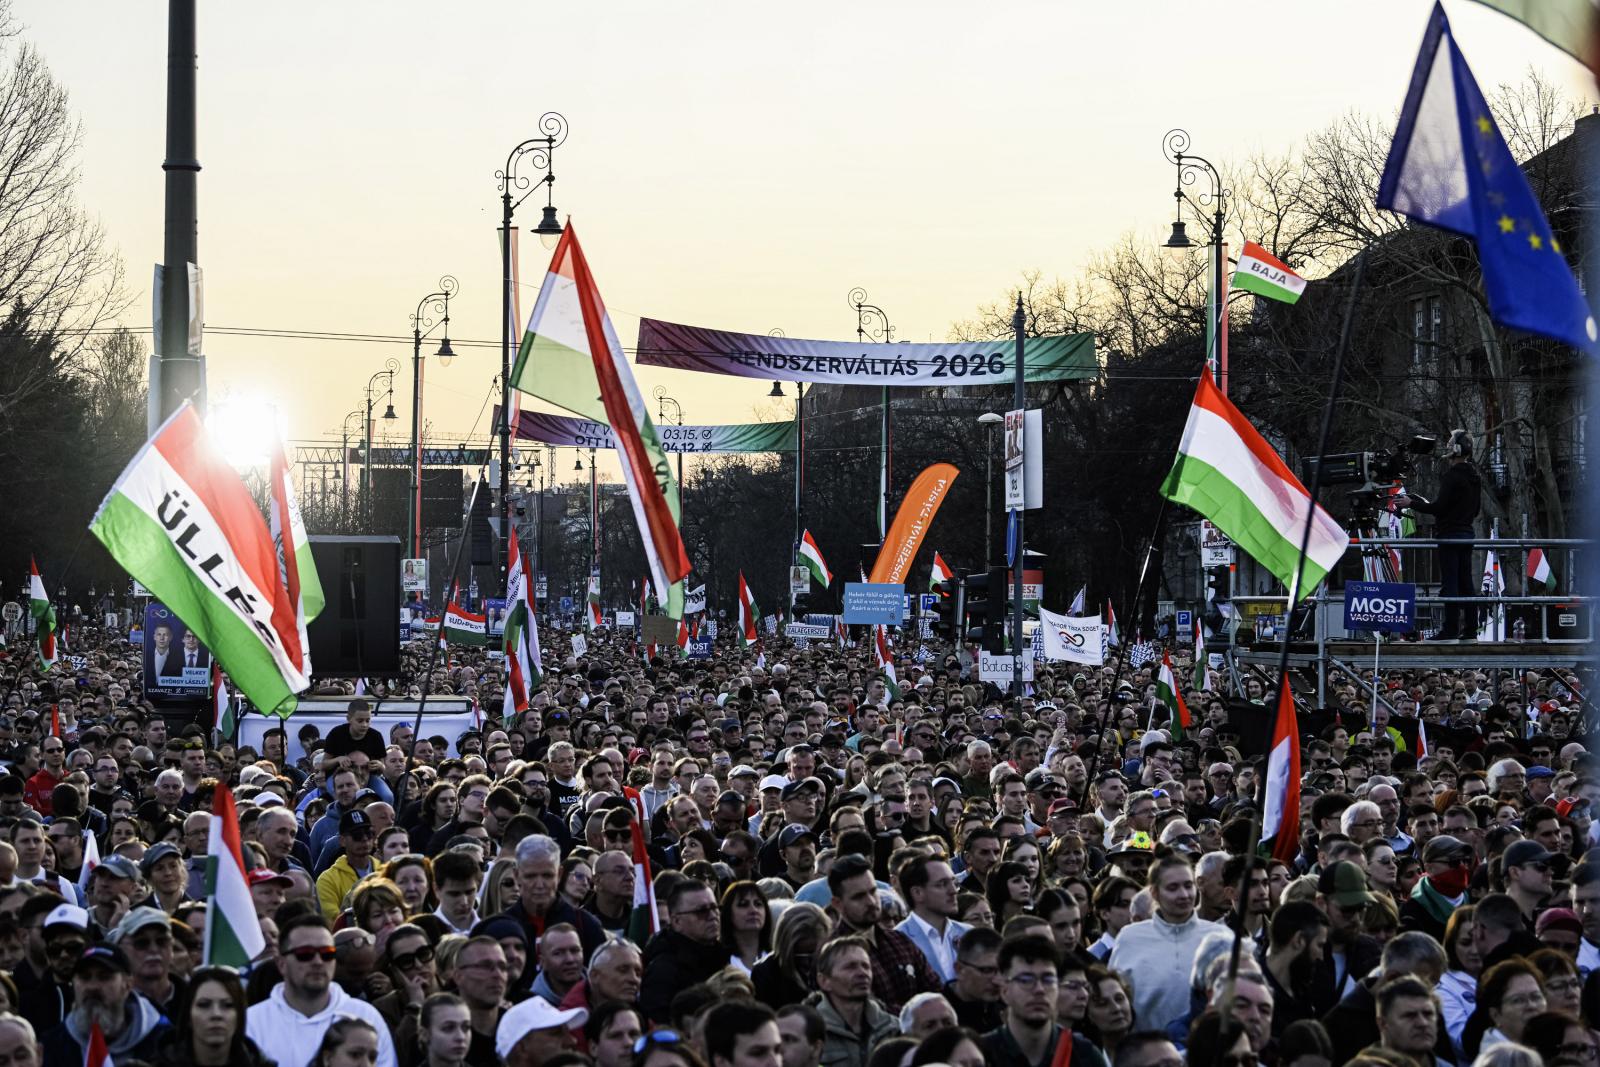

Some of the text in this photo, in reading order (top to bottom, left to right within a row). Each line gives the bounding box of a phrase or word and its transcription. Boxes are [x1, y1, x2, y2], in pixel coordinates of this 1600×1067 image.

[1251, 262, 1286, 284] BAJA
[729, 352, 1006, 378] RENDSZERVÁLTÁS 2026
[578, 423, 602, 434] ITT
[663, 429, 698, 440] 03.15.
[575, 435, 601, 446] OTT
[662, 441, 699, 453] 04.12.
[1350, 597, 1409, 615] MOST
[1180, 613, 1188, 623] P
[1350, 613, 1408, 624] VAGY SOHA!
[787, 626, 827, 635] ZALAEGERSZEG
[63, 655, 87, 663] TISZA
